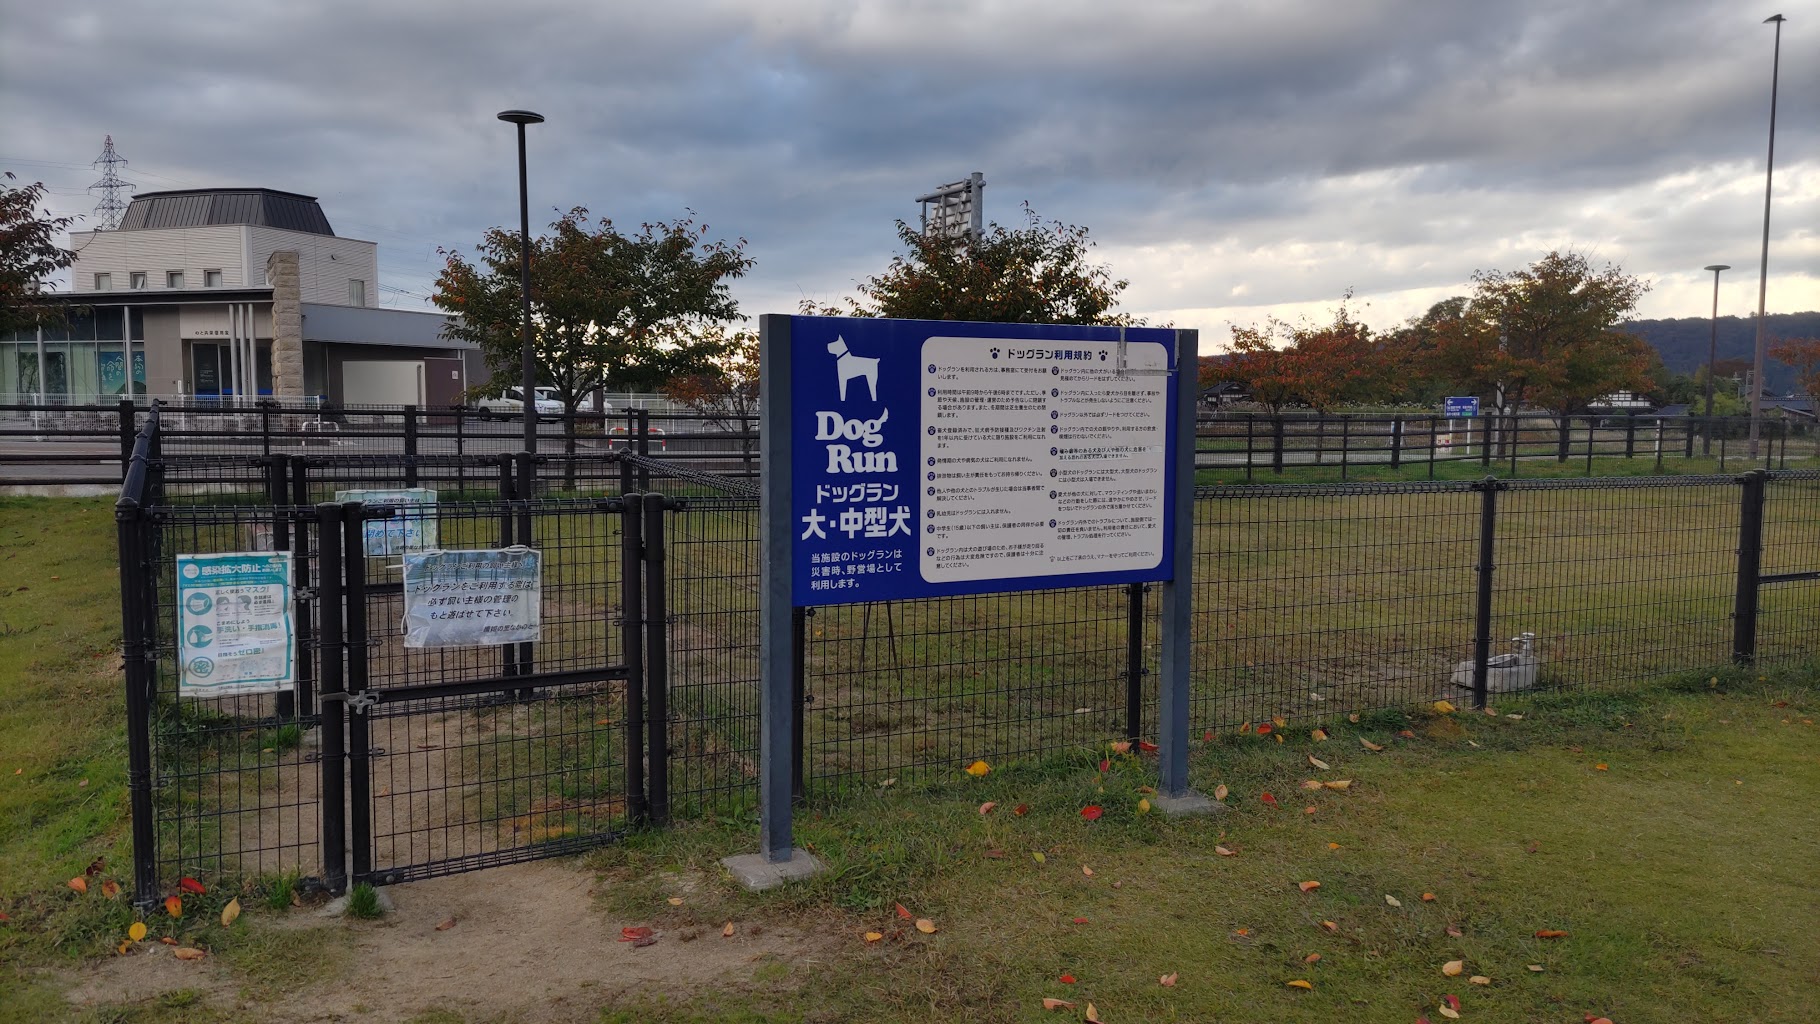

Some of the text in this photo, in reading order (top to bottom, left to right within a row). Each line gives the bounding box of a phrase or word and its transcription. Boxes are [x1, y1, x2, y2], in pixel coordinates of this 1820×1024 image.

[1008, 348, 1092, 360] ドッグラン利用規約
[815, 407, 889, 448] Dog
[826, 444, 898, 474] Run
[816, 482, 898, 504] ドッグラン
[802, 506, 911, 541] 大・中型犬
[812, 549, 902, 564] 当施設のドッグランは
[202, 564, 261, 576] 感染拡大防止
[811, 562, 902, 578] 災害時、野営場として
[414, 580, 533, 594] ドッグランをご利用する際は
[810, 578, 860, 590] 利用します。
[428, 594, 519, 606] 必ず飼い主様の管理の
